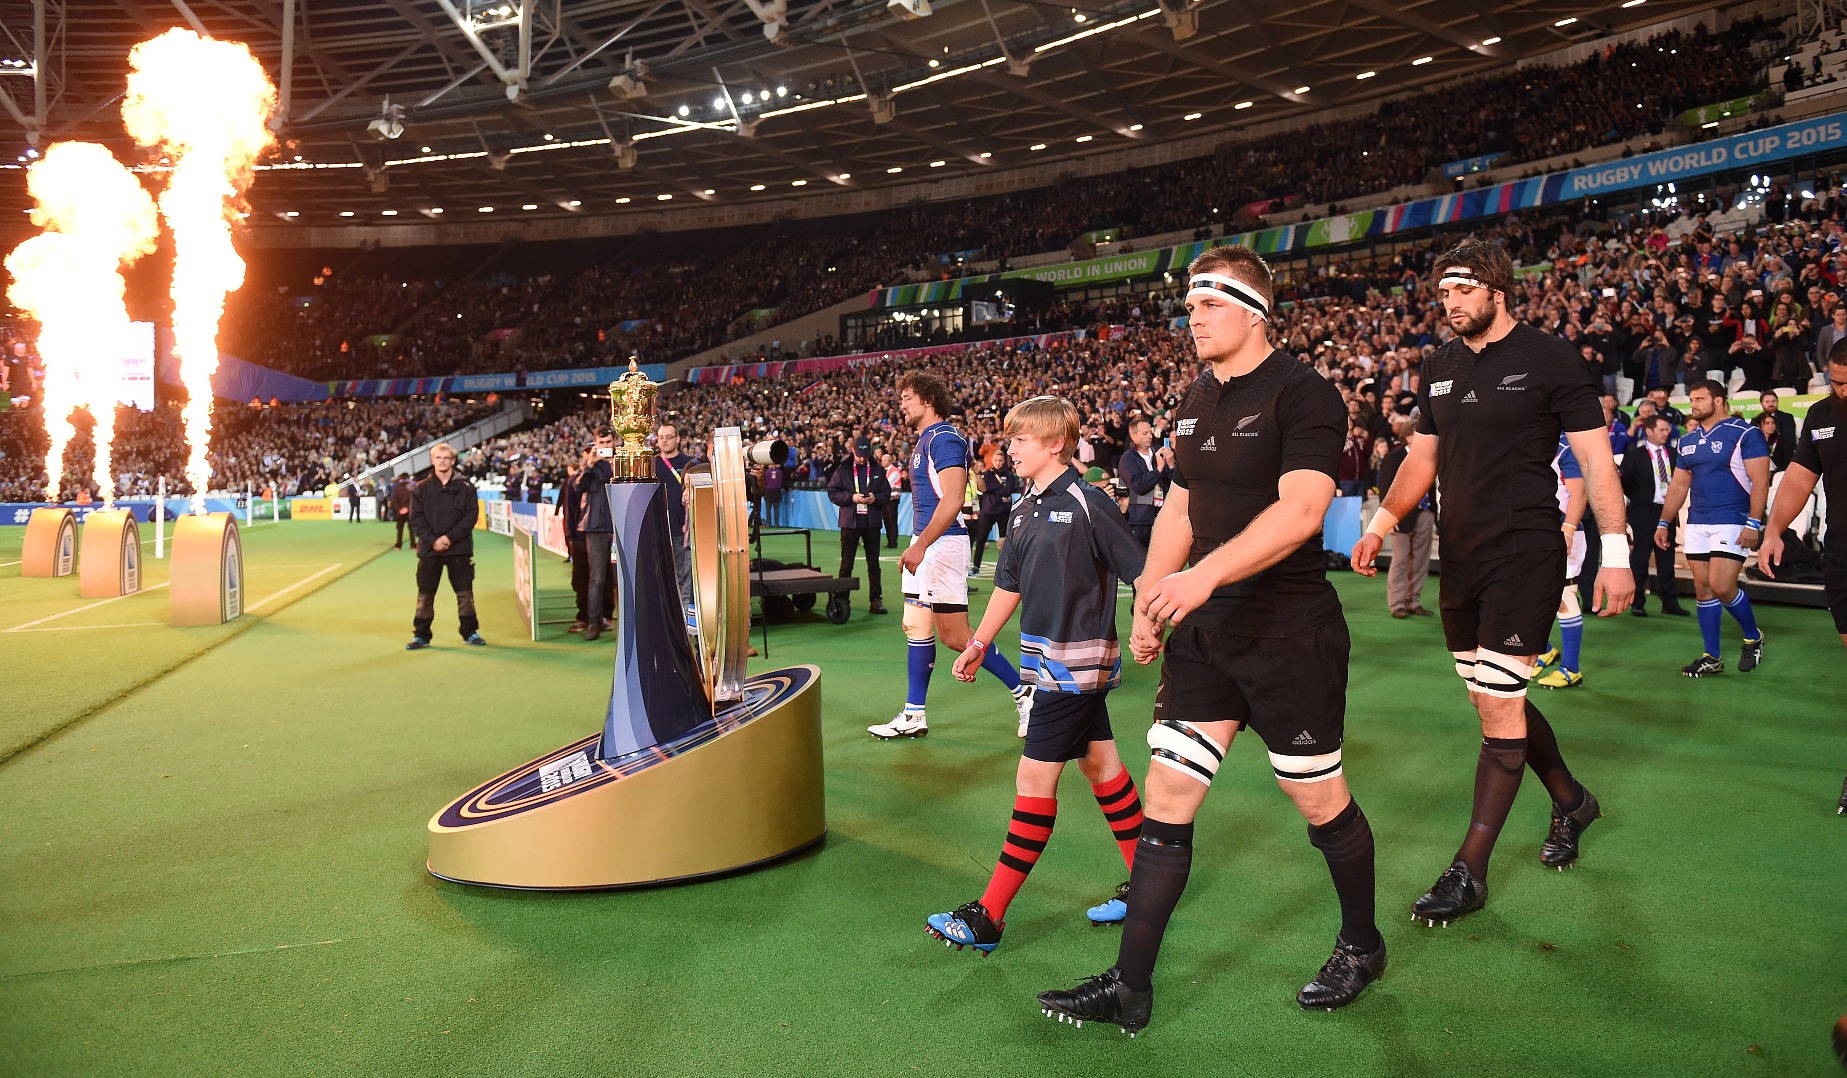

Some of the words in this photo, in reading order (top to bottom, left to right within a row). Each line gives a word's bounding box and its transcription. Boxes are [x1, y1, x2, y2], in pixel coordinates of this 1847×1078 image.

[1573, 163, 1643, 191] RUGBY
[1648, 148, 1727, 176] WORLD
[1734, 135, 1780, 160] CUP
[1786, 122, 1842, 149] 2015
[1036, 267, 1083, 282] WORLD
[1087, 264, 1100, 277] IN
[1104, 257, 1147, 274] UNION
[463, 378, 500, 389] RUGBY
[546, 373, 568, 385] CUP
[571, 371, 596, 384] 2015
[299, 504, 324, 513] DHL
[1292, 738, 1317, 746] adidas
